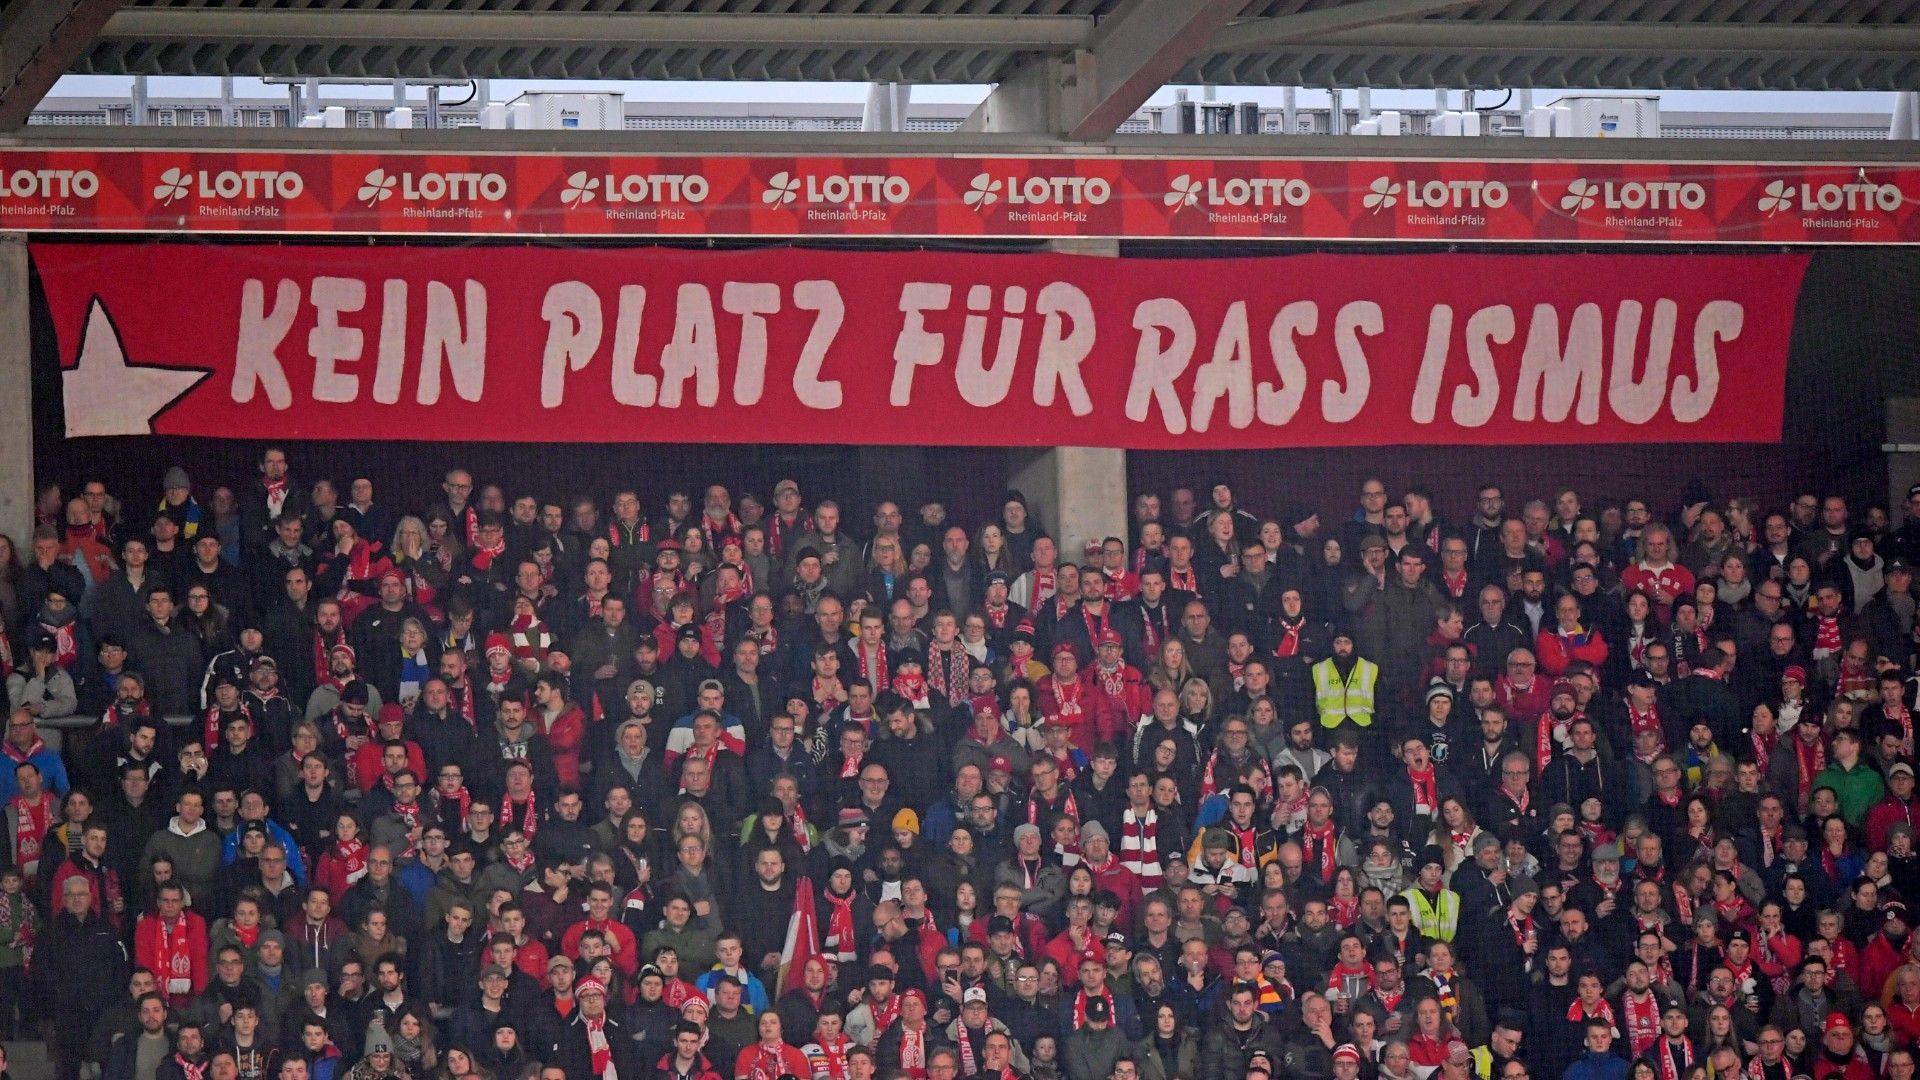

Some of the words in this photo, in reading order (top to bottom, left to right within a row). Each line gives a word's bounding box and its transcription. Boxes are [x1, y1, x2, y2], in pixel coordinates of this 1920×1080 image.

[0, 170, 98, 198] LOTTO
[200, 170, 304, 199] LOTTO
[403, 172, 506, 201] LOTTO
[604, 174, 708, 203] LOTTO
[806, 174, 910, 204] LOTTO
[1007, 176, 1110, 205] LOTTO
[1208, 177, 1310, 207] LOTTO
[1406, 179, 1508, 209] LOTTO
[1604, 181, 1705, 210] LOTTO
[1802, 183, 1902, 212] LOTTO
[0, 205, 75, 215] heinland-Pfalz
[199, 205, 279, 217] Rheinland-Pfalz
[403, 207, 483, 219] Rheinland-Pfalz
[605, 208, 685, 220] Rheinland-Pfalz
[807, 209, 887, 221] Rheinland-Pfalz
[1008, 210, 1088, 222] Rheinland-Pfalz
[1208, 212, 1288, 224] Rheinland-Pfalz
[1407, 214, 1486, 226] Rheinland-Pfalz
[1605, 216, 1683, 227] Rheinland-Pfalz
[1802, 217, 1880, 229] Rheinland-Pfalz
[231, 277, 488, 409] KEIN
[541, 280, 846, 409] PLATZ
[889, 281, 1097, 416] FÜR
